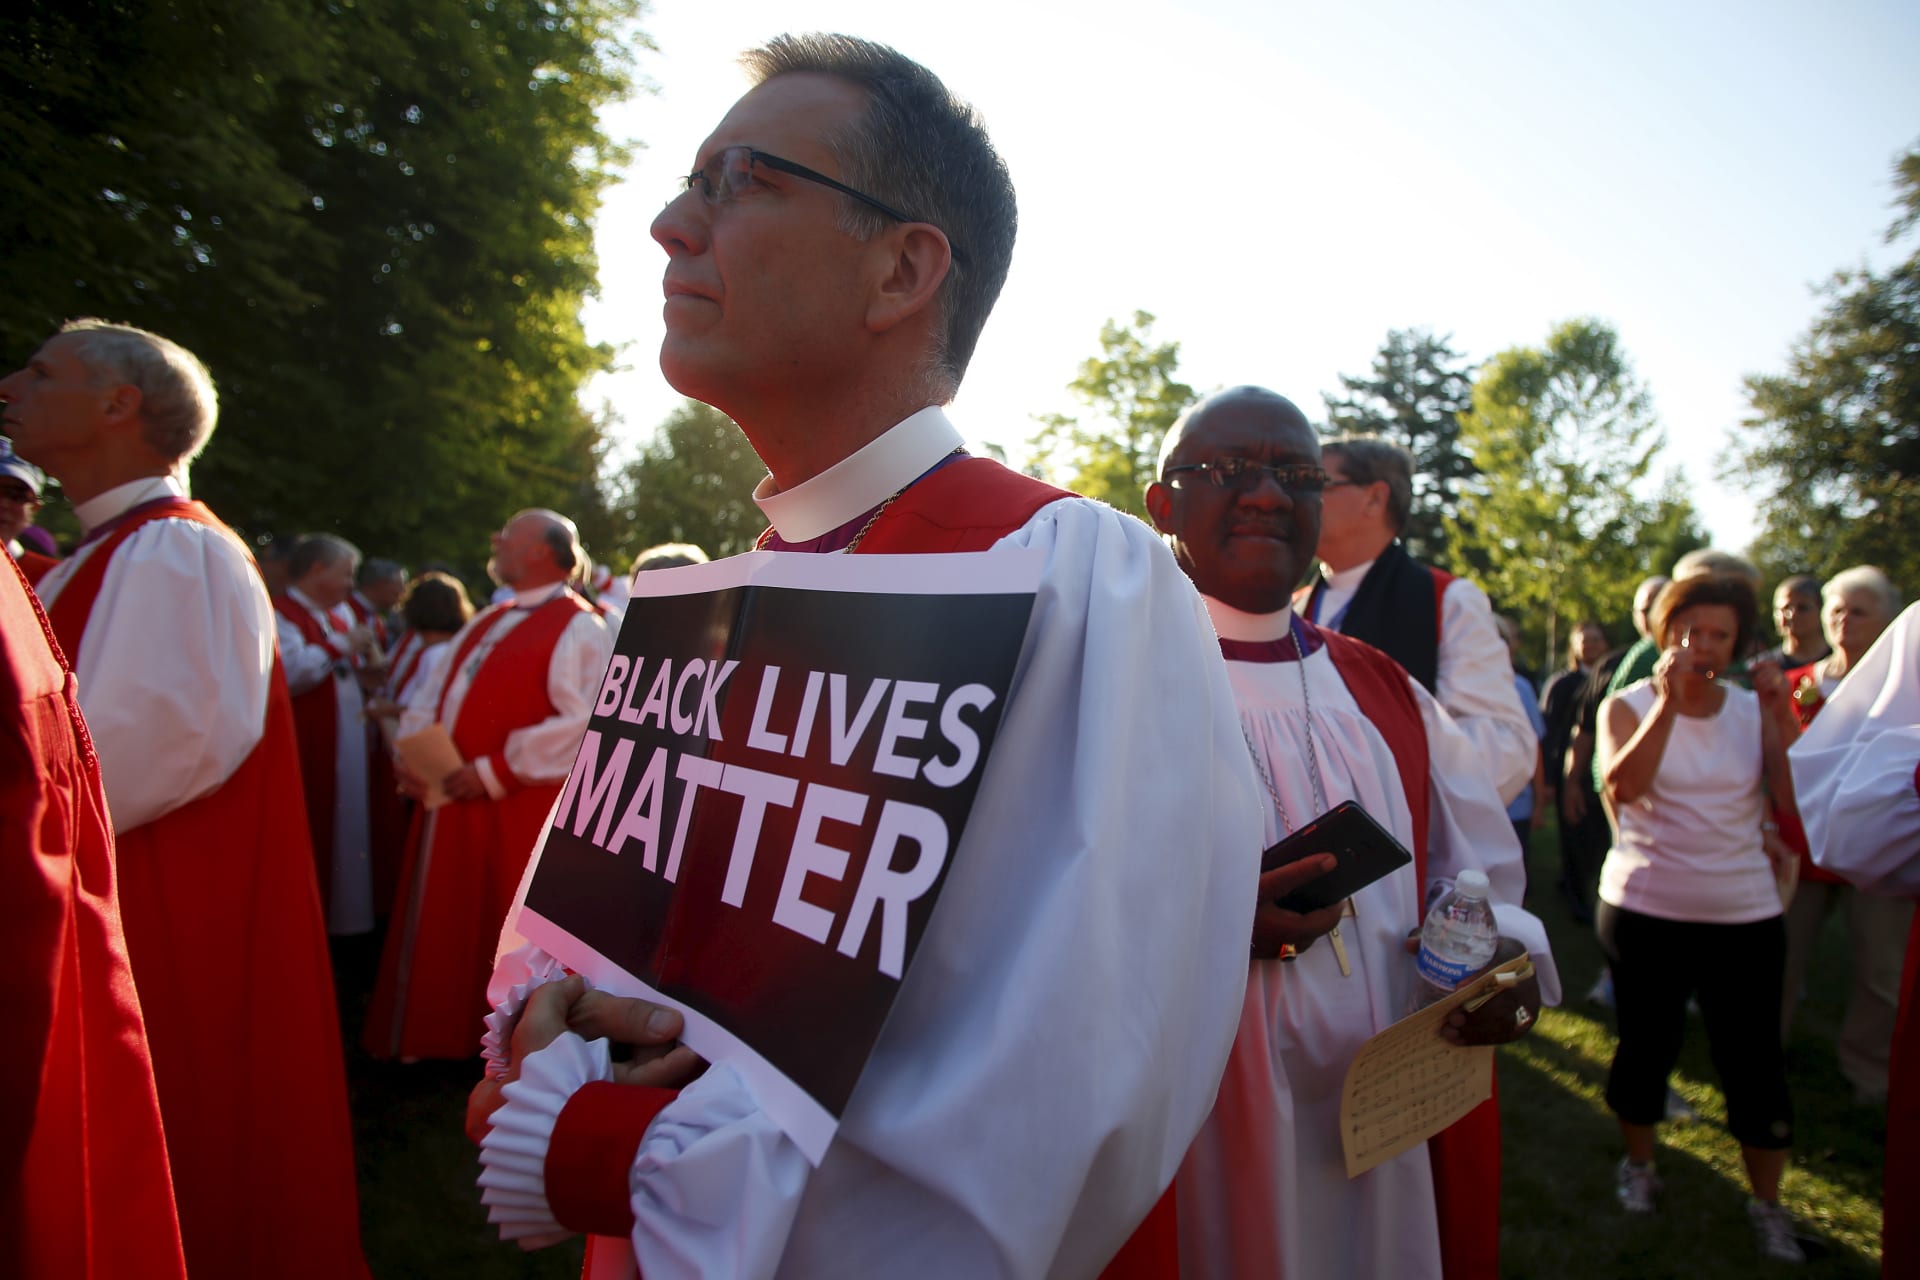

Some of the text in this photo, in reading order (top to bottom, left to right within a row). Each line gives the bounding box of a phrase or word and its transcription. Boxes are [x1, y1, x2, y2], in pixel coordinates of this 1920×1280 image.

[594, 653, 997, 788] BLACK LIVES
[553, 730, 950, 981] MATTER
